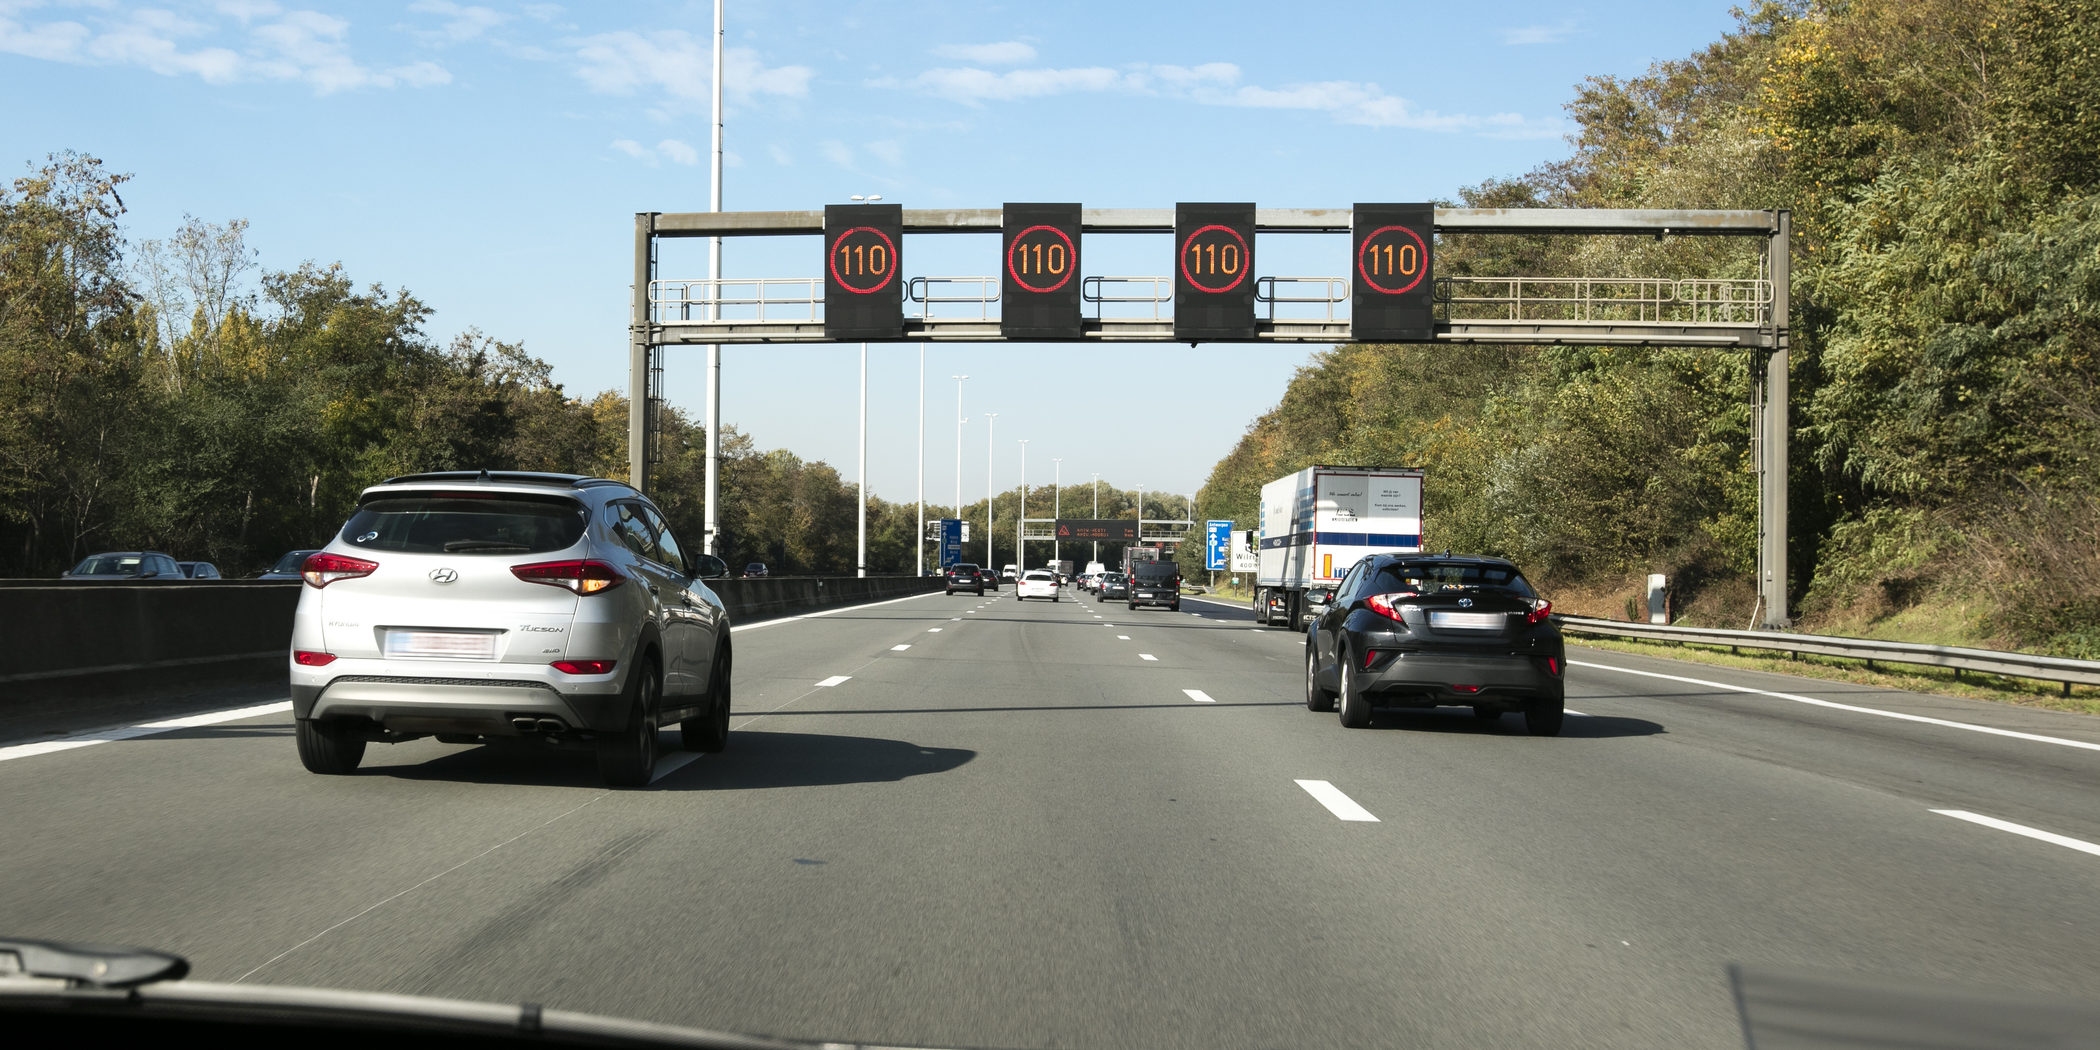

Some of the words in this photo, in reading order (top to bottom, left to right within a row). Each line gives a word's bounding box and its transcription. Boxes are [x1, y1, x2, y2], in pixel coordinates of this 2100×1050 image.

[841, 245, 885, 275] 110
[1019, 244, 1064, 274] 110
[1192, 244, 1238, 274] 110
[1370, 245, 1416, 275] 110
[519, 624, 564, 633] TUCSON
